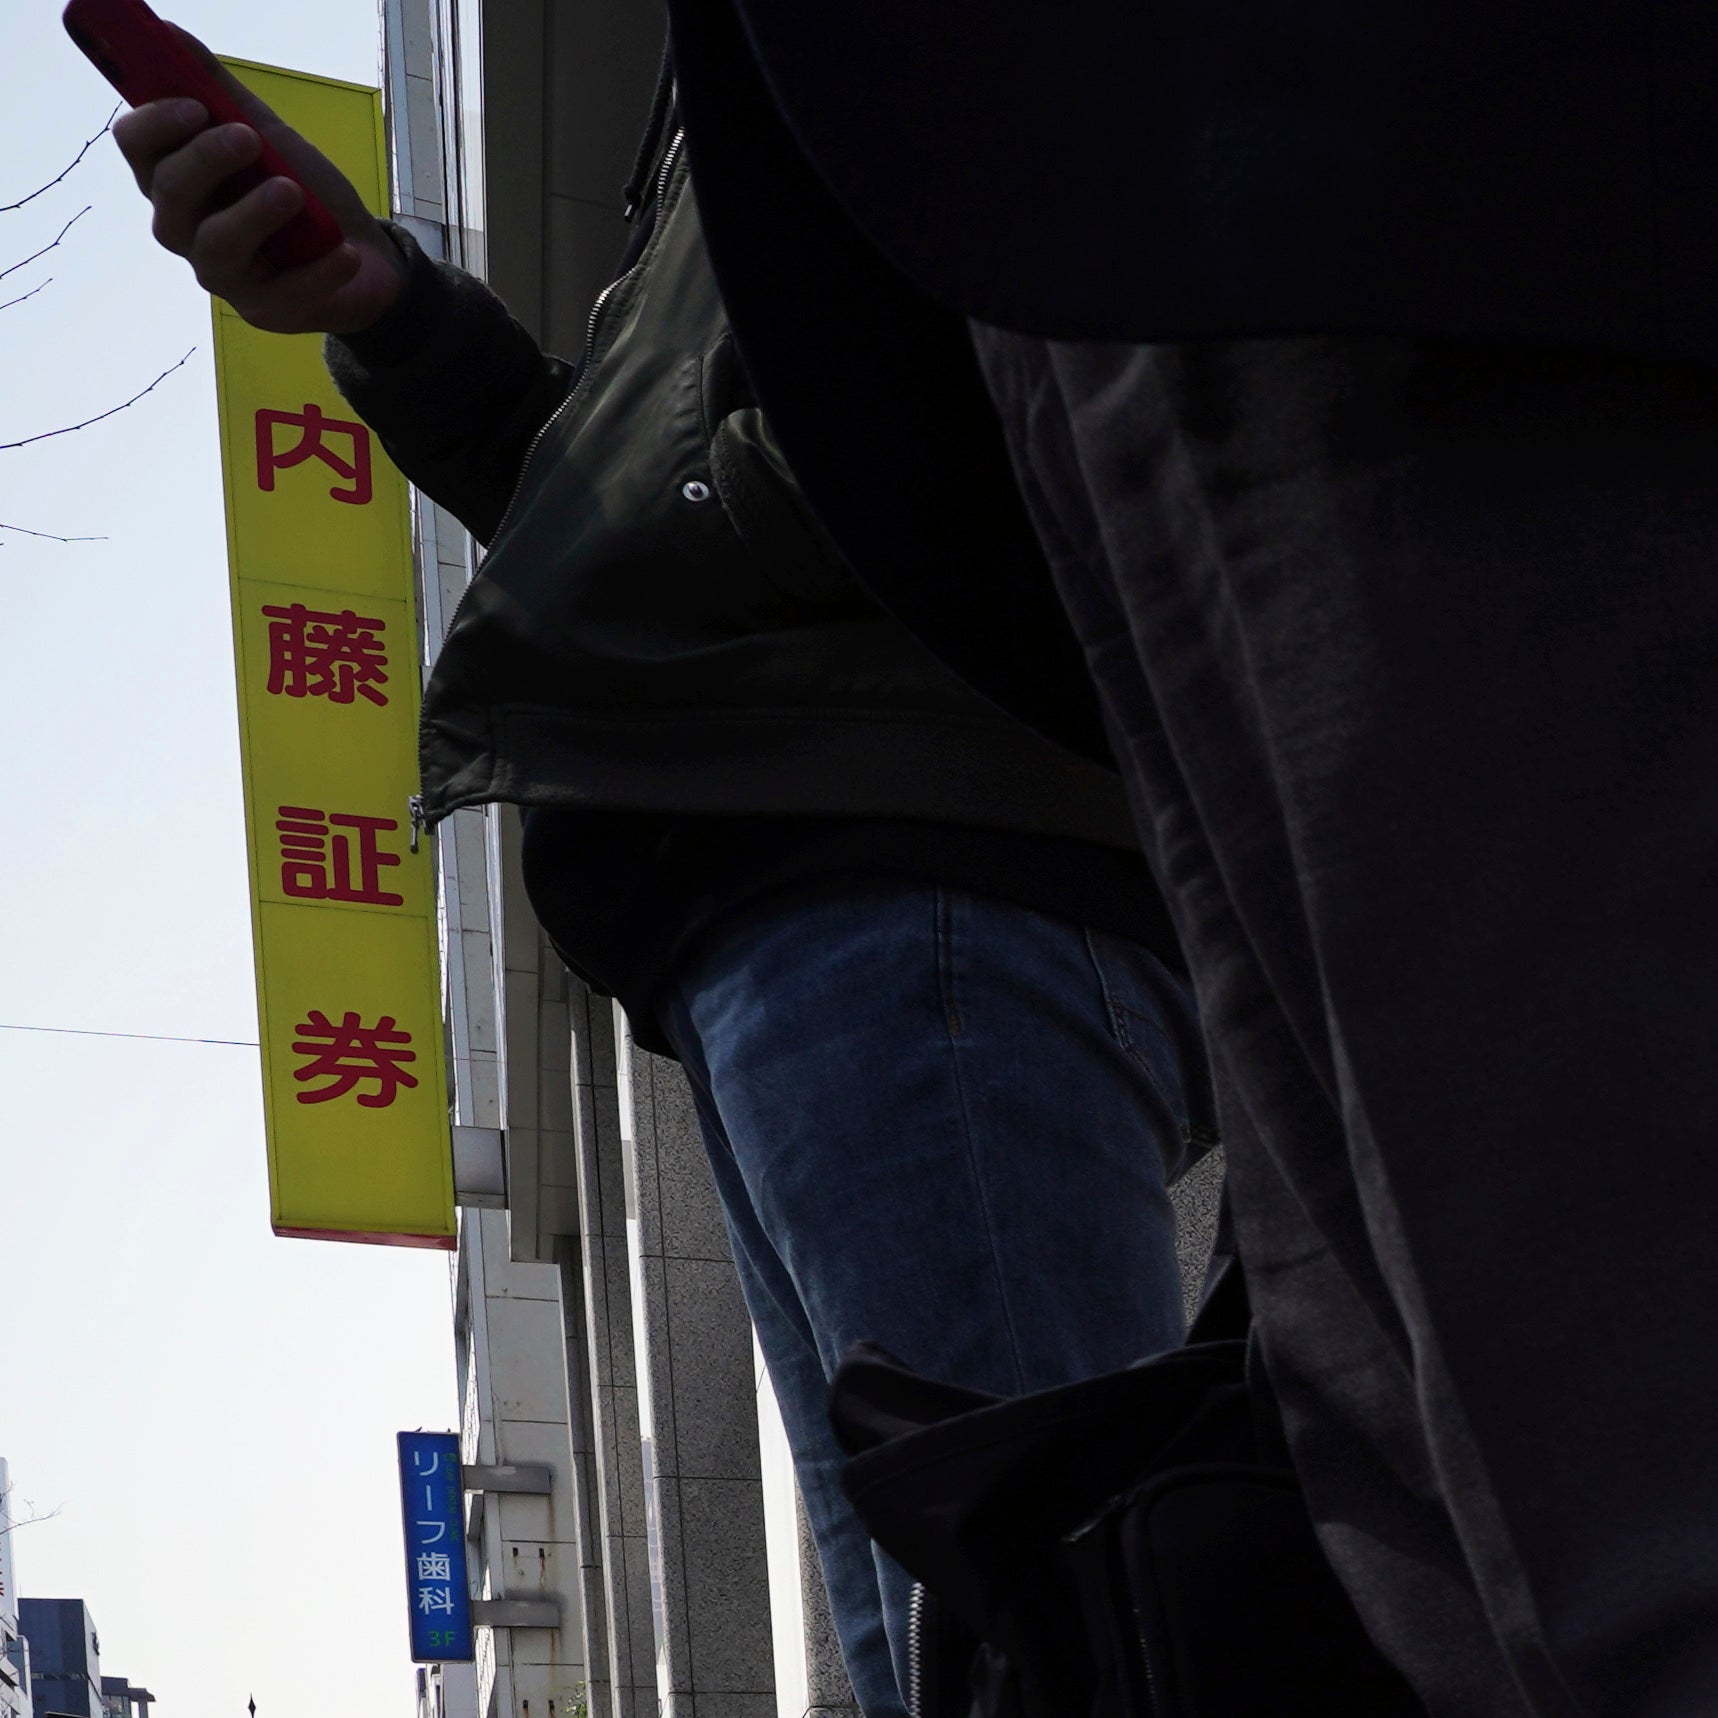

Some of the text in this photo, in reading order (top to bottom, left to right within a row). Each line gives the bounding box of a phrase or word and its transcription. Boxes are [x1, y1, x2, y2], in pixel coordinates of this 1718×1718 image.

[255, 403, 419, 1108] 内藤証券
[414, 1451, 454, 1615] リーフ歯科
[429, 1631, 457, 1647] 3F
